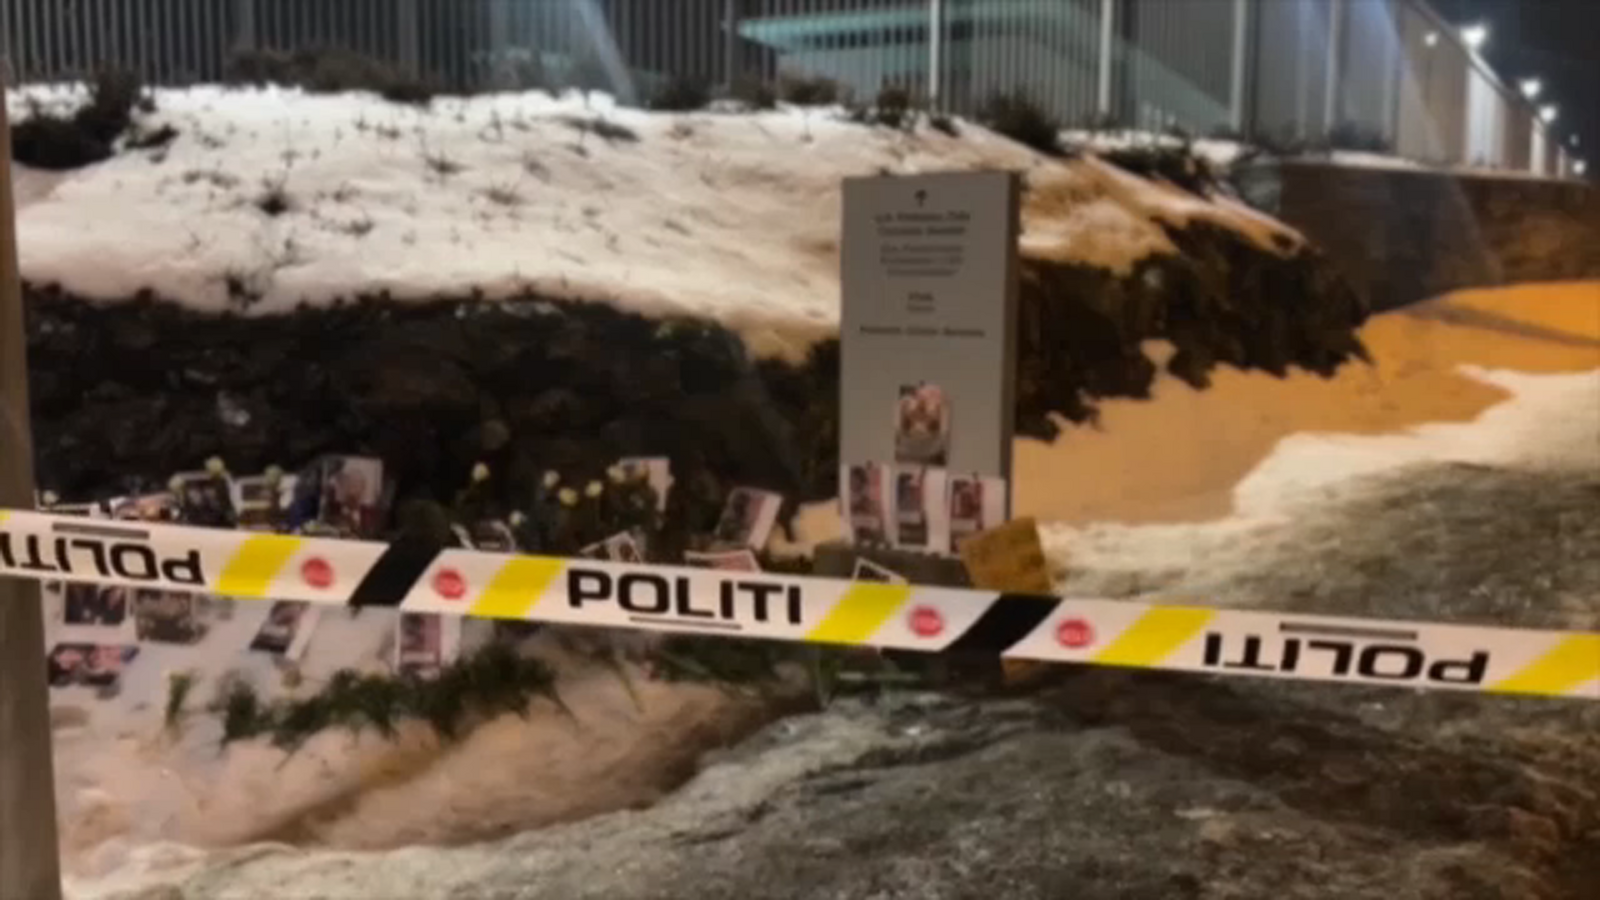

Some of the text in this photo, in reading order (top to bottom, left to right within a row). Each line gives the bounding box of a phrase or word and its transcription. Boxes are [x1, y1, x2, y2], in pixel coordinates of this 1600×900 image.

[0, 532, 205, 584] POLITI
[567, 568, 802, 625] POLITI
[1203, 631, 1490, 684] POLITI
